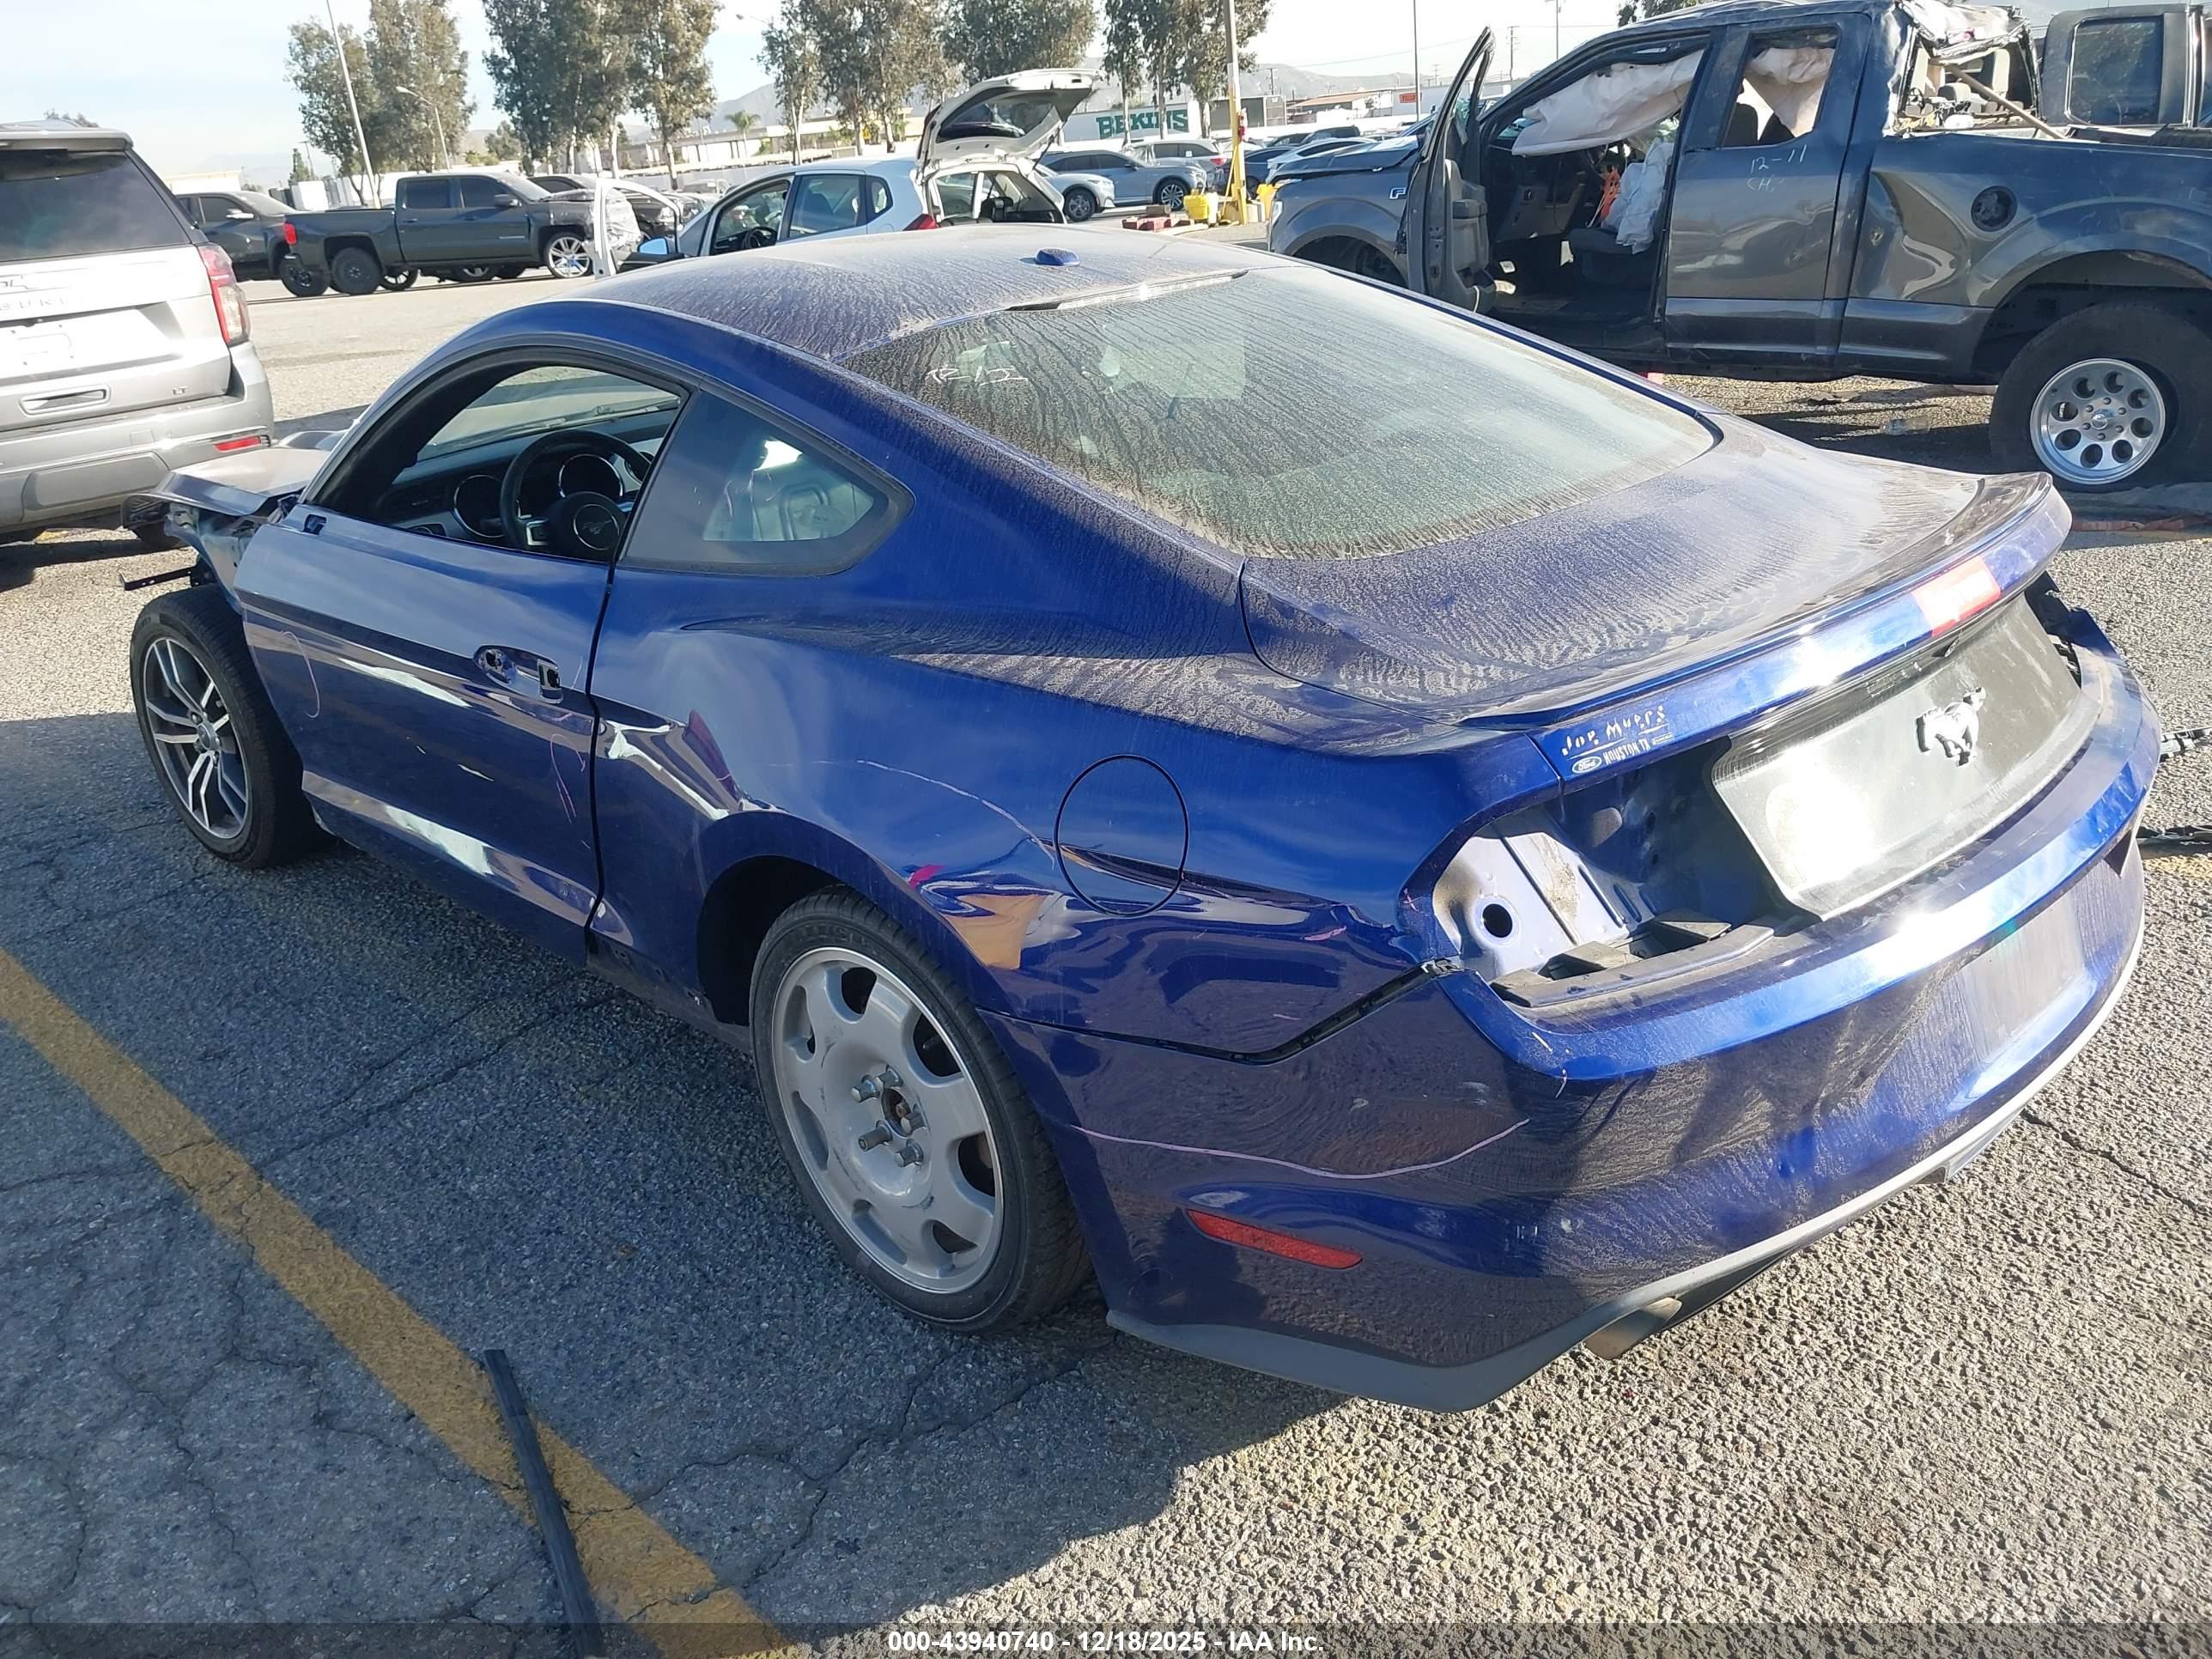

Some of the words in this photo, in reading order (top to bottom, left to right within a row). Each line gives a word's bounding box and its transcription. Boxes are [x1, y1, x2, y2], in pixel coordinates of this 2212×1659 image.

[1096, 110, 1189, 140] BEKINS
[172, 386, 187, 396] LT
[1602, 742, 1639, 765] HOUSTON
[1639, 738, 1651, 754] TX
